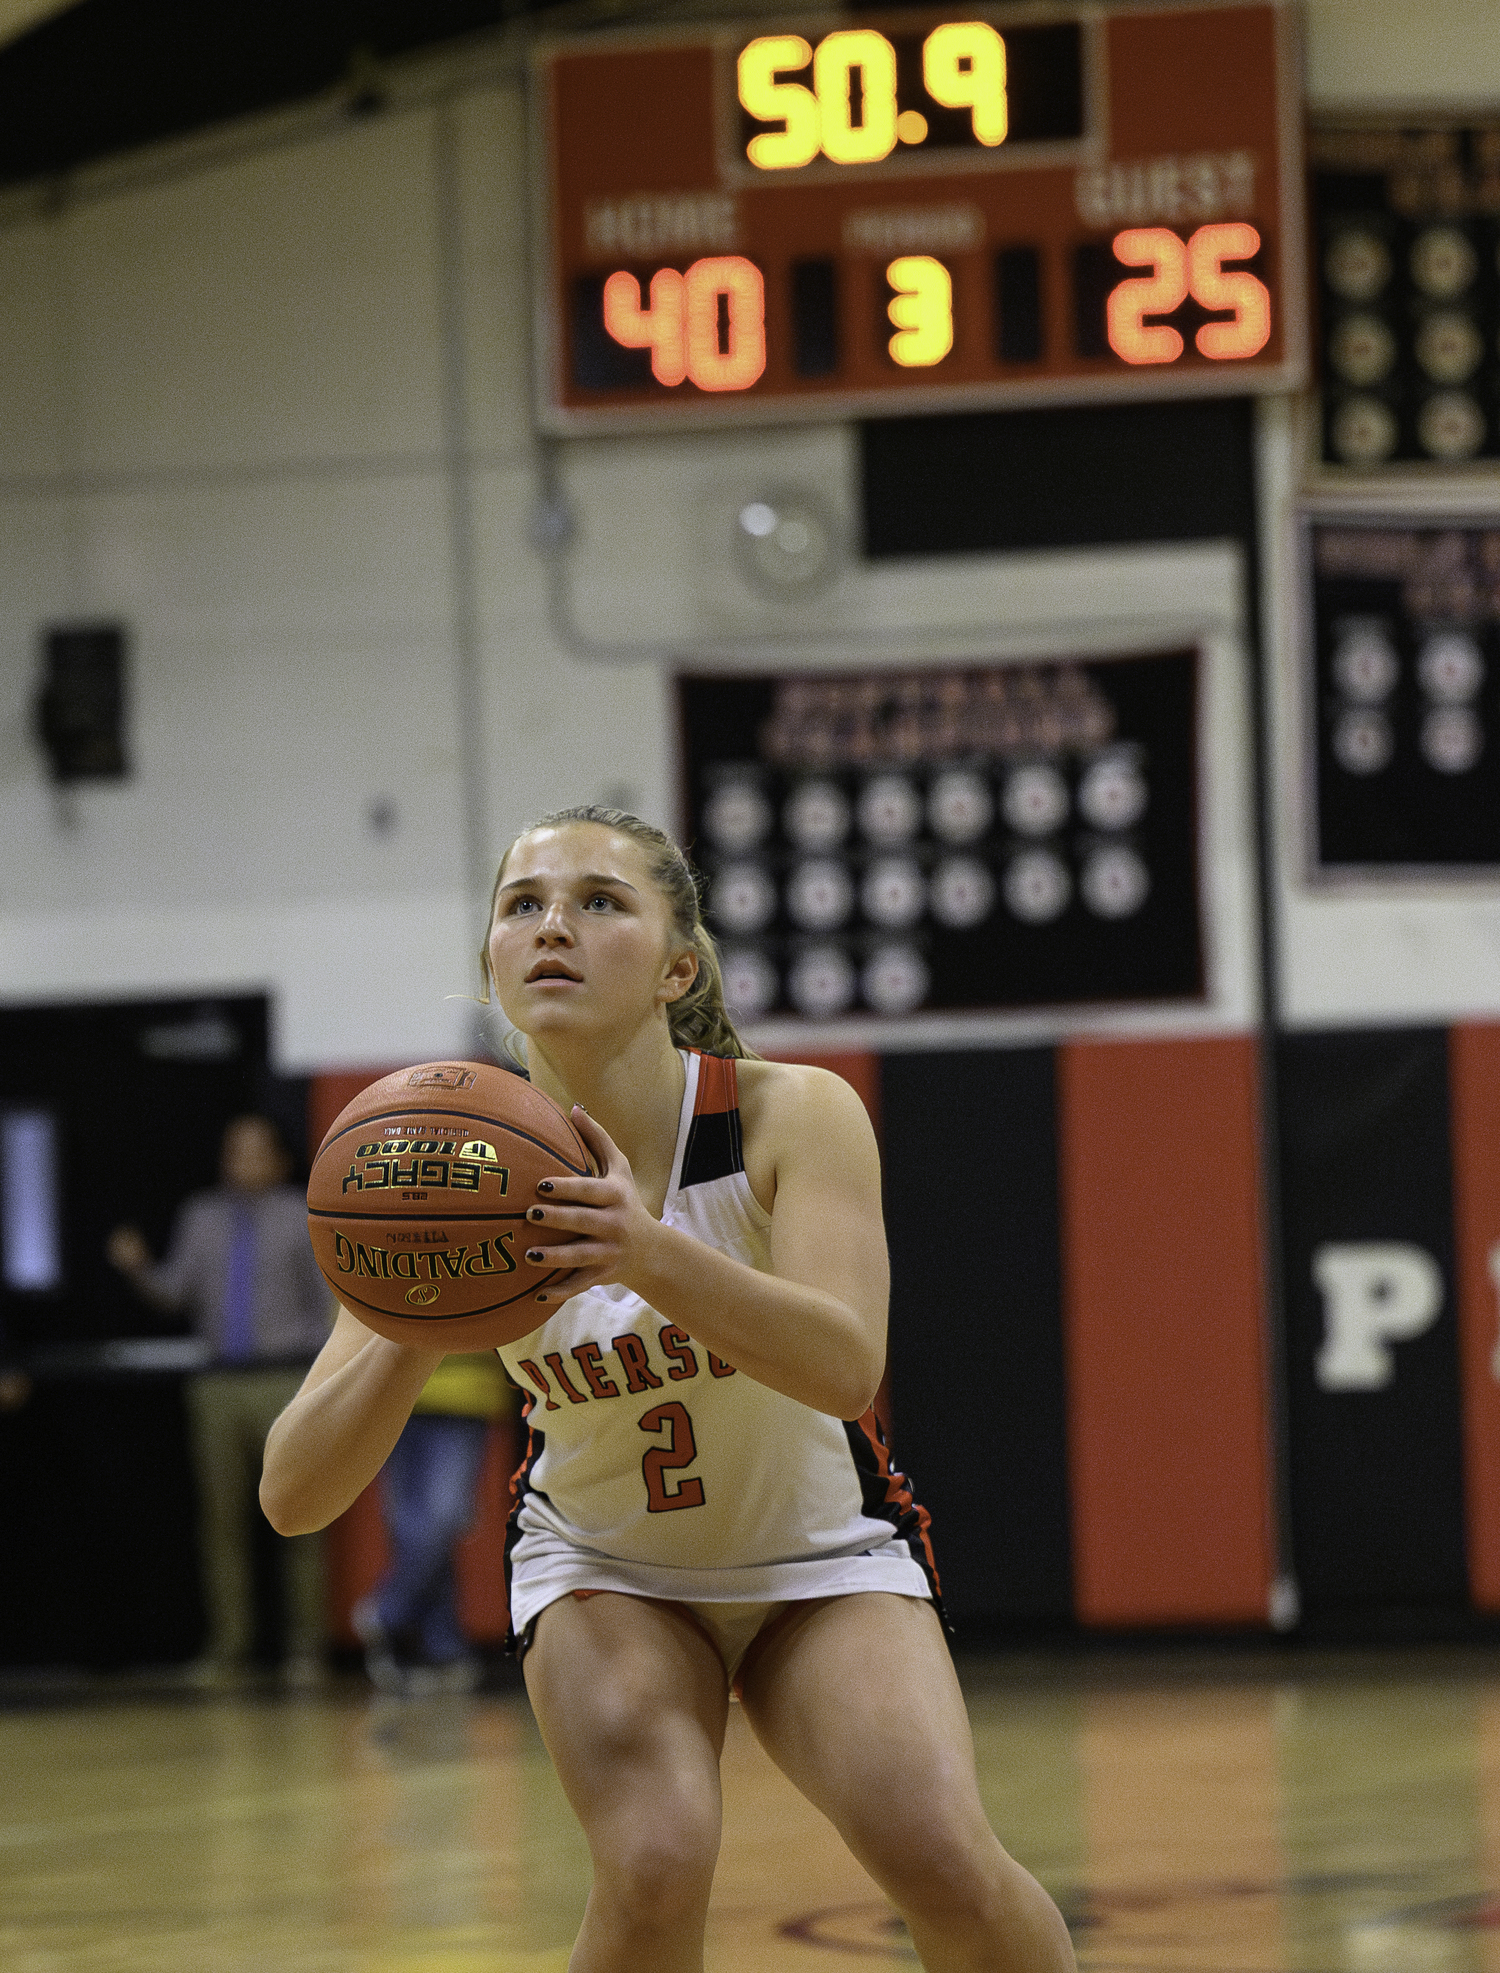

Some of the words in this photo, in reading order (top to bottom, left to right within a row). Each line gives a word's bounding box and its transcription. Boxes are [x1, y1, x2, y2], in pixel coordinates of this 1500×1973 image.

[737, 21, 1008, 171] 50.9
[603, 255, 766, 391] 40
[886, 255, 954, 367] 3
[1106, 222, 1271, 365] 25
[341, 1159, 510, 1197] LEGACY
[335, 1229, 518, 1280] SPALDING
[637, 1400, 706, 1513] 2
